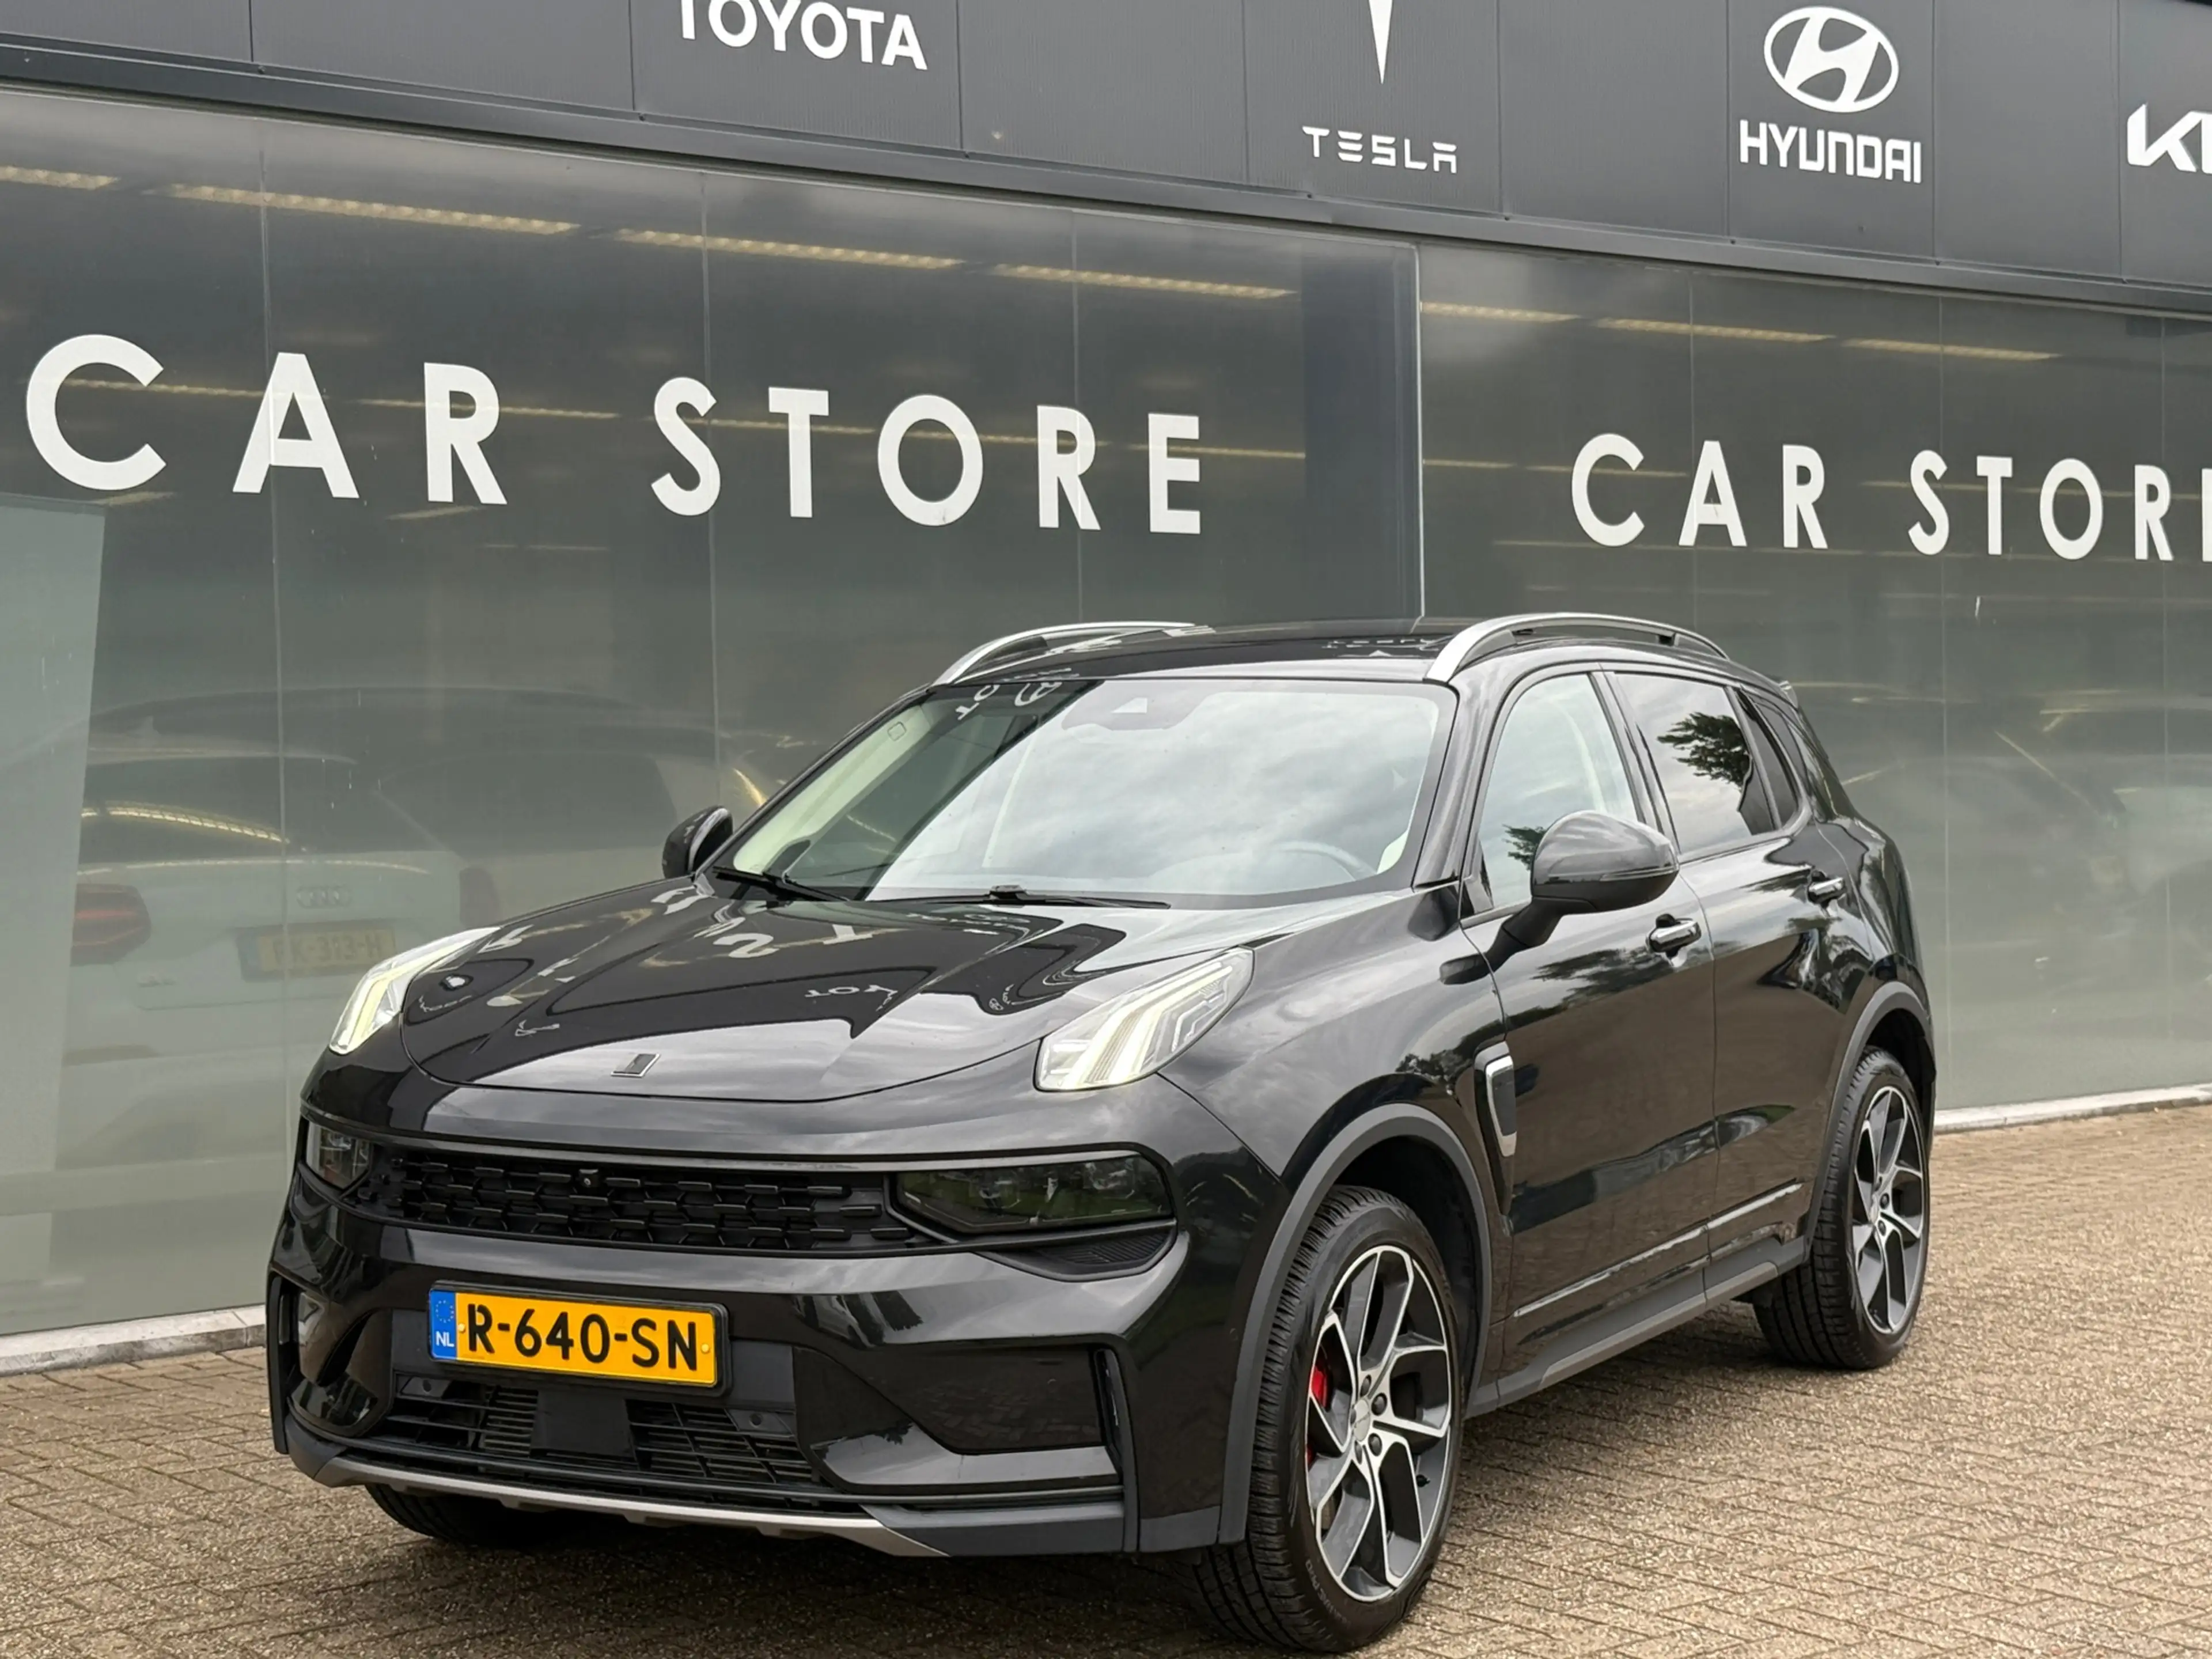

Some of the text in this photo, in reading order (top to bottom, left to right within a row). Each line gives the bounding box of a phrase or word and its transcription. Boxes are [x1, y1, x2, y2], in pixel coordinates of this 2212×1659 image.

[1302, 126, 1457, 174] TESLA
[1739, 119, 1922, 184] HYUNDAI
[26, 334, 1200, 534] CAR STORE
[1571, 433, 1828, 549] CAR
[435, 1331, 454, 1347] NL
[467, 1304, 697, 1370] R-640-SN
